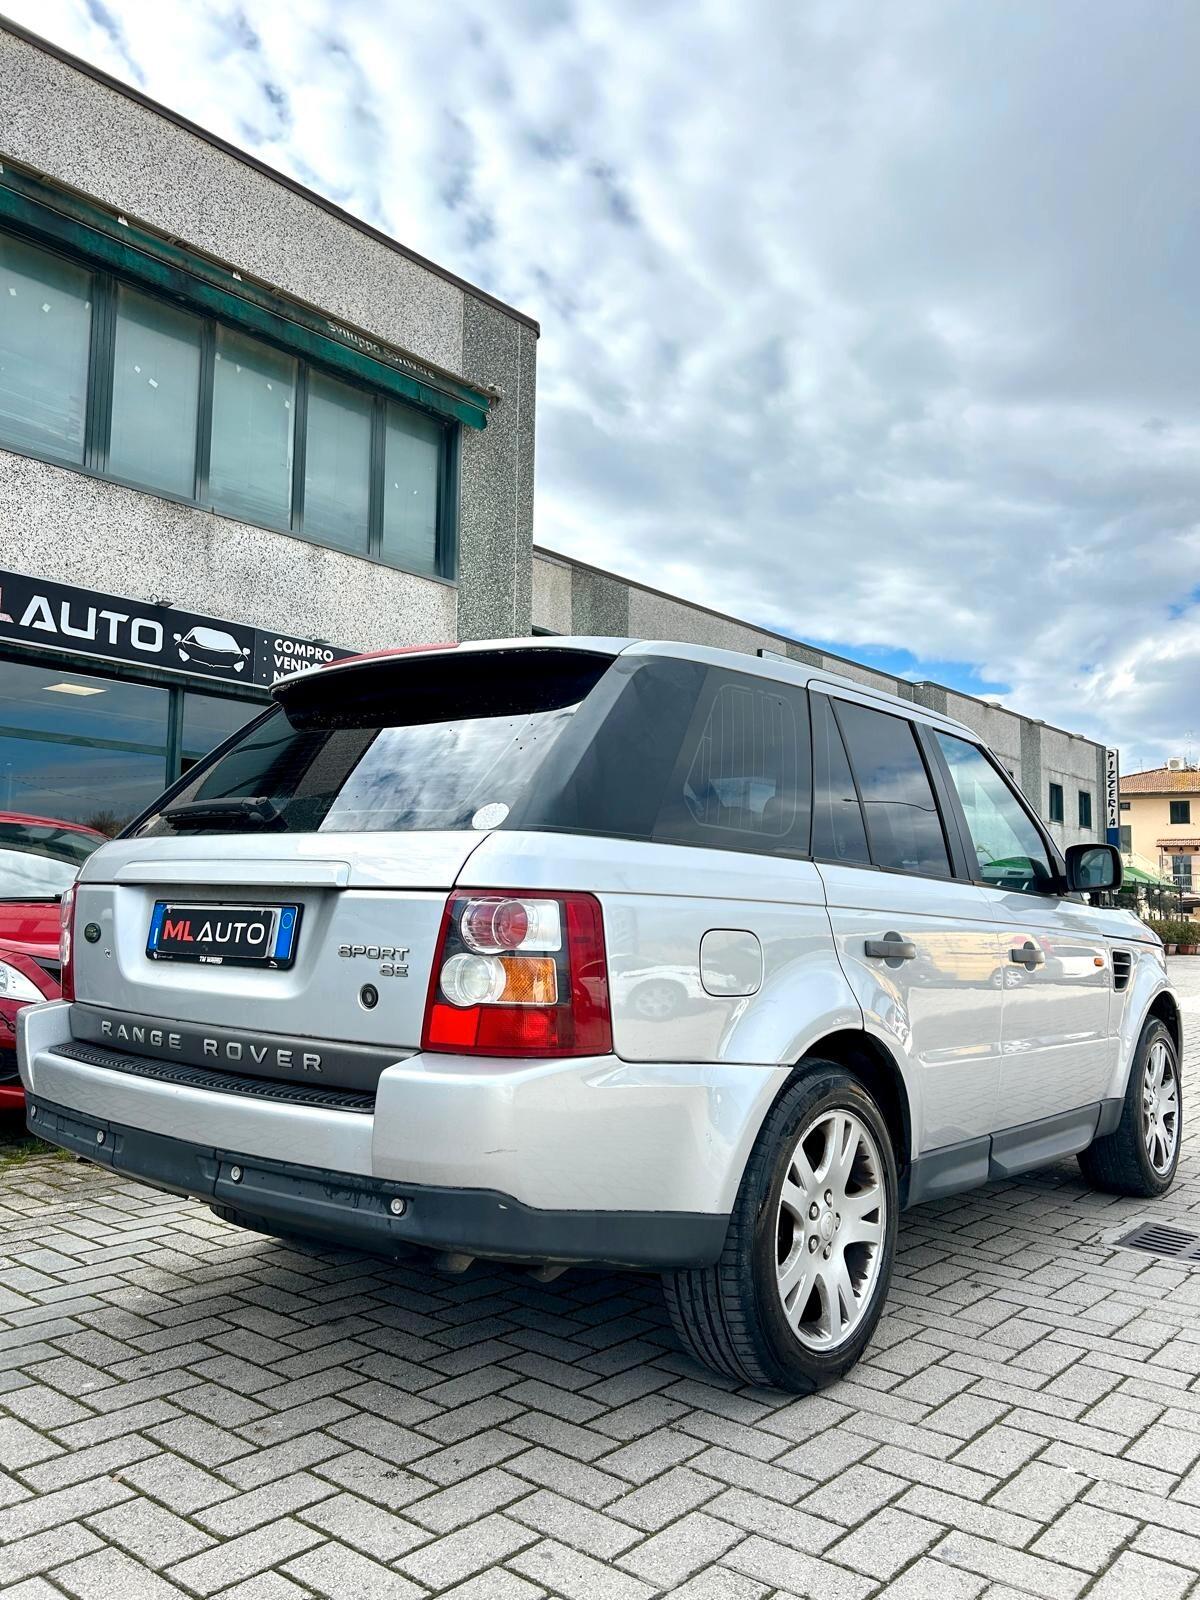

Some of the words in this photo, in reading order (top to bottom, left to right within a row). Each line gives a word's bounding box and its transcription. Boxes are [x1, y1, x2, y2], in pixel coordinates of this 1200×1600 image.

[19, 595, 164, 652] AUTO
[274, 639, 334, 662] COMPRO
[1107, 751, 1116, 827] PIZZERIA
[338, 944, 410, 961] SPORT
[379, 962, 409, 977] SE
[101, 1020, 182, 1050] RANGE
[203, 1038, 322, 1072] ROVER
